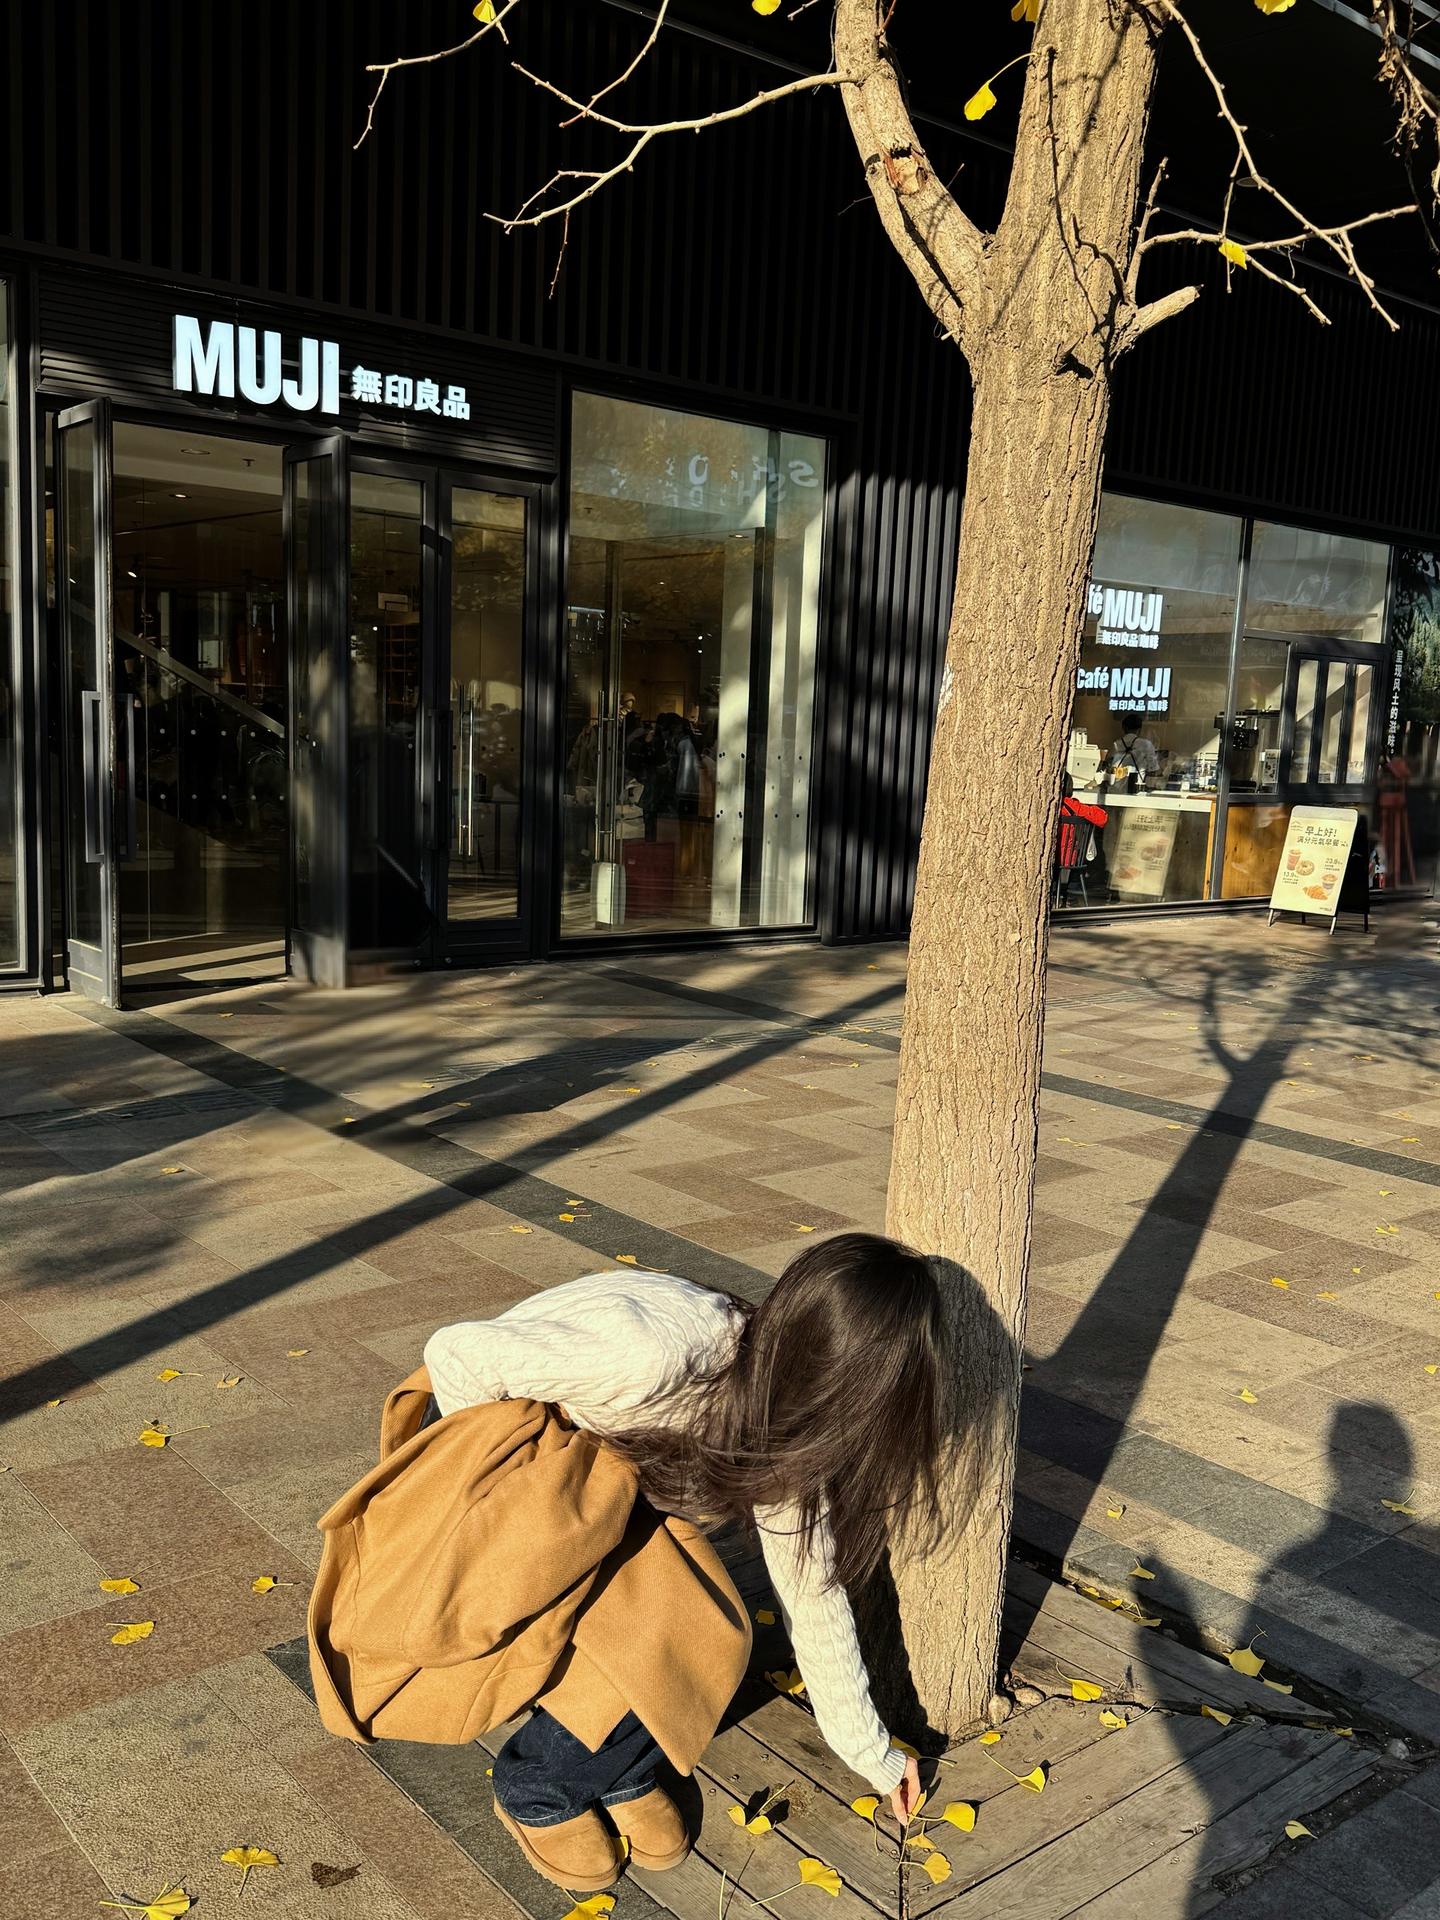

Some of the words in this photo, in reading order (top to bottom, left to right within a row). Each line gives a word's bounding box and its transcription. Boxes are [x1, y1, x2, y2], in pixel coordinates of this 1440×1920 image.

[172, 314, 340, 415] MUJI
[351, 365, 471, 421] 無印良品
[1088, 584, 1104, 615] fé
[1103, 588, 1164, 632] MUJI
[1102, 630, 1139, 648] 無印良品
[1077, 666, 1110, 689] Café
[1110, 667, 1172, 698] MUJI
